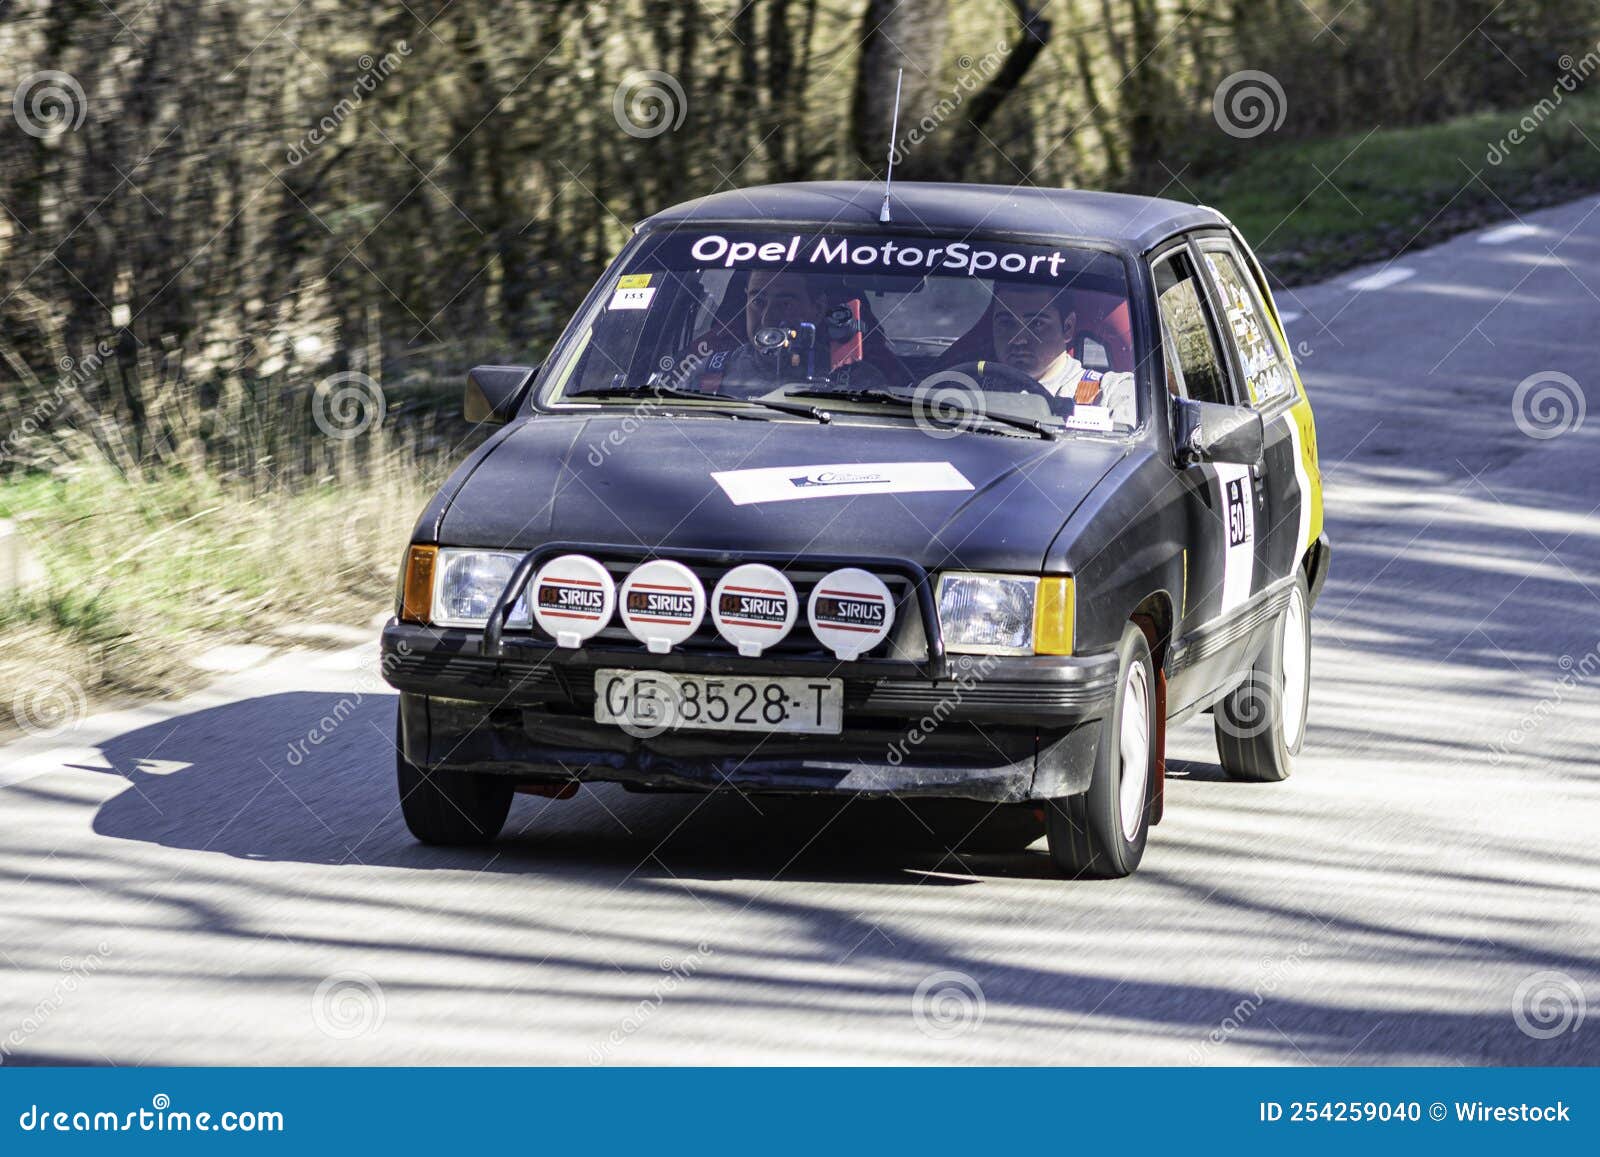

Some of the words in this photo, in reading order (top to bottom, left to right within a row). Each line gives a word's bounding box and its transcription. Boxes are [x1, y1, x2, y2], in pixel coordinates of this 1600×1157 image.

[691, 235, 801, 268] Opel
[809, 237, 1066, 277] MotorSport
[1230, 502, 1244, 543] 50
[558, 588, 603, 607] SIRIUS
[647, 594, 693, 612] SIRIUS
[740, 597, 785, 616] SIRIUS
[837, 601, 883, 620] SIRIUS
